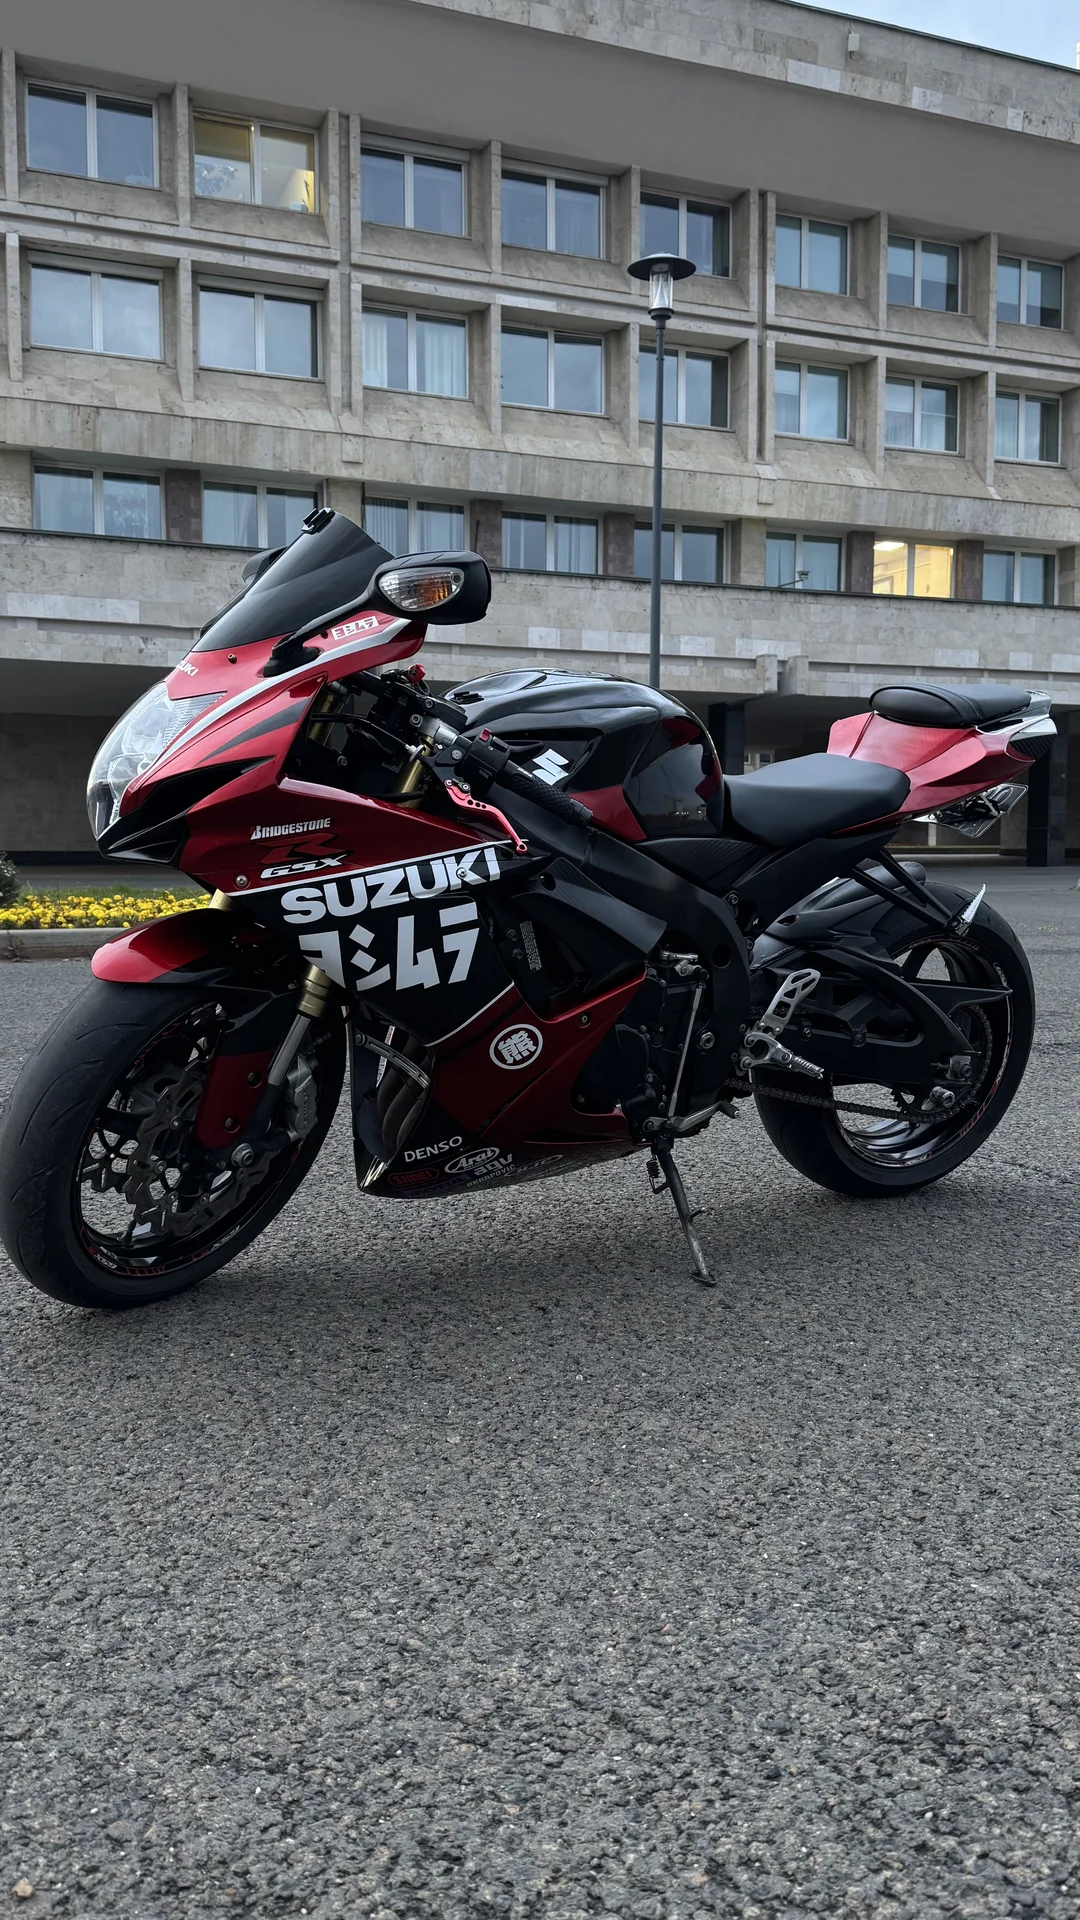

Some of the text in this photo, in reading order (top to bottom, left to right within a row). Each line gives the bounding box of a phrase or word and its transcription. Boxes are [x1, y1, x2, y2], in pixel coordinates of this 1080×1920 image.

[333, 617, 375, 638] ヨシムラ
[250, 817, 331, 840] BRIDGESTONE
[260, 853, 348, 879] GSX
[280, 846, 501, 925] SUZUKI
[298, 901, 480, 992] ヨシムラ
[403, 1135, 464, 1163] DENSO
[451, 1150, 496, 1172] Arai
[473, 1153, 513, 1176] agv
[391, 1170, 435, 1186] SHOEI
